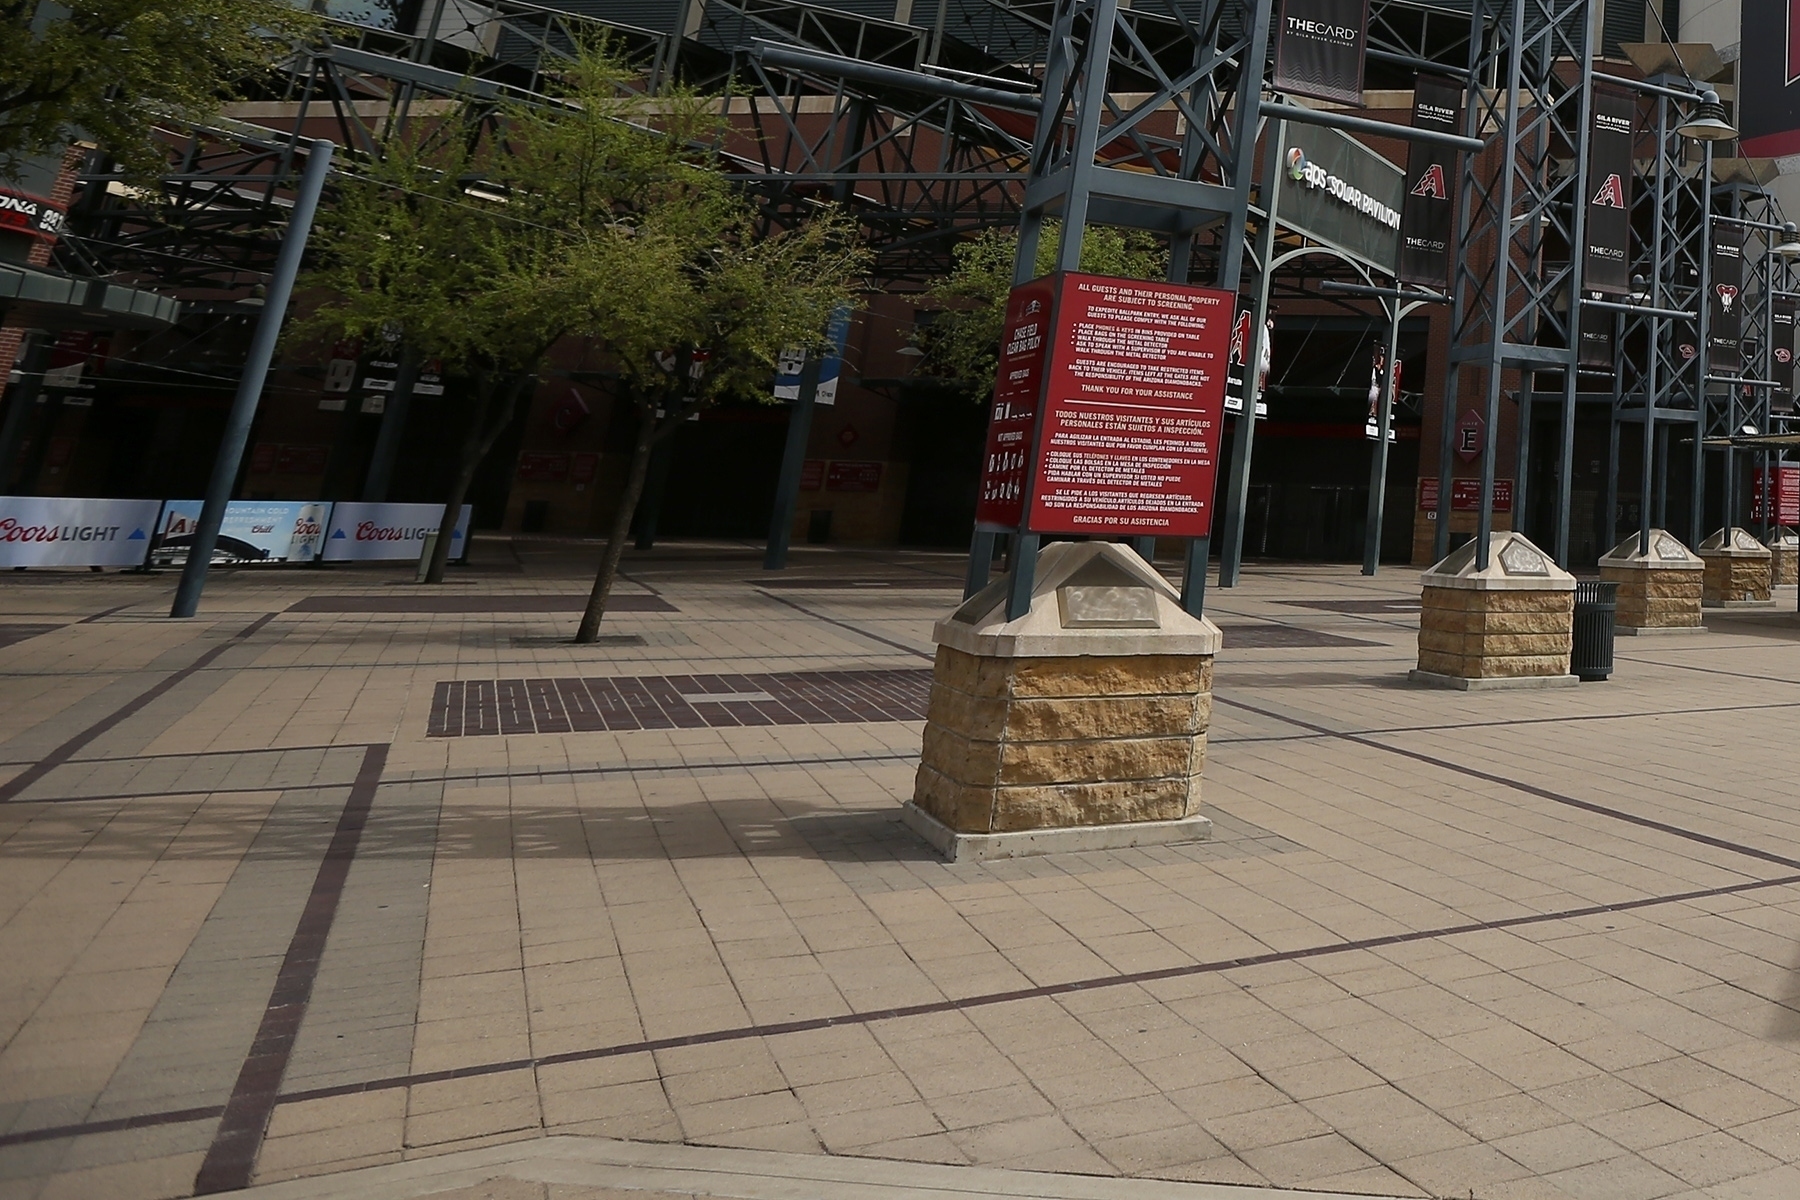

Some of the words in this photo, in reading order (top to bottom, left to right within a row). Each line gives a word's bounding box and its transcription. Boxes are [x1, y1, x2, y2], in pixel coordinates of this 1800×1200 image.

[1418, 103, 1433, 112] GILA
[1434, 106, 1454, 116] RIVER
[1597, 114, 1610, 122] GILA
[1302, 161, 1327, 189] aps
[1326, 176, 1361, 210] SOLAR
[1362, 194, 1401, 230] PAVILION
[1078, 283, 1089, 291] ALL
[1091, 284, 1116, 294] GUESTS
[1118, 287, 1132, 296] AND
[1134, 289, 1152, 298] THEIR
[1154, 292, 1186, 302] PERSONAL
[1187, 295, 1219, 305] PROPERTY
[1118, 295, 1145, 305] SUBJECT
[1157, 300, 1194, 310] SCREENING.
[1081, 383, 1103, 392] THANK
[1134, 388, 1152, 396] YOUR
[1154, 390, 1193, 399] ASSISTANCE
[1055, 410, 1077, 418] TODOS
[1078, 412, 1114, 421] NUESTROS
[1115, 414, 1153, 423] VISITANTES
[1176, 417, 1210, 427] ARTÍCULOS
[1060, 419, 1103, 428] PERSONALES
[1105, 421, 1126, 430] ESTÁN
[1128, 423, 1155, 431] SUJETOS
[1163, 424, 1203, 435] INSPECCIÓN.
[1460, 428, 1477, 452] E
[1073, 515, 1102, 523] GRACIAS
[1130, 517, 1169, 526] ASISTENCIA
[0, 517, 60, 542] Coors
[60, 526, 120, 542] LIGHT
[356, 520, 404, 541] Coors
